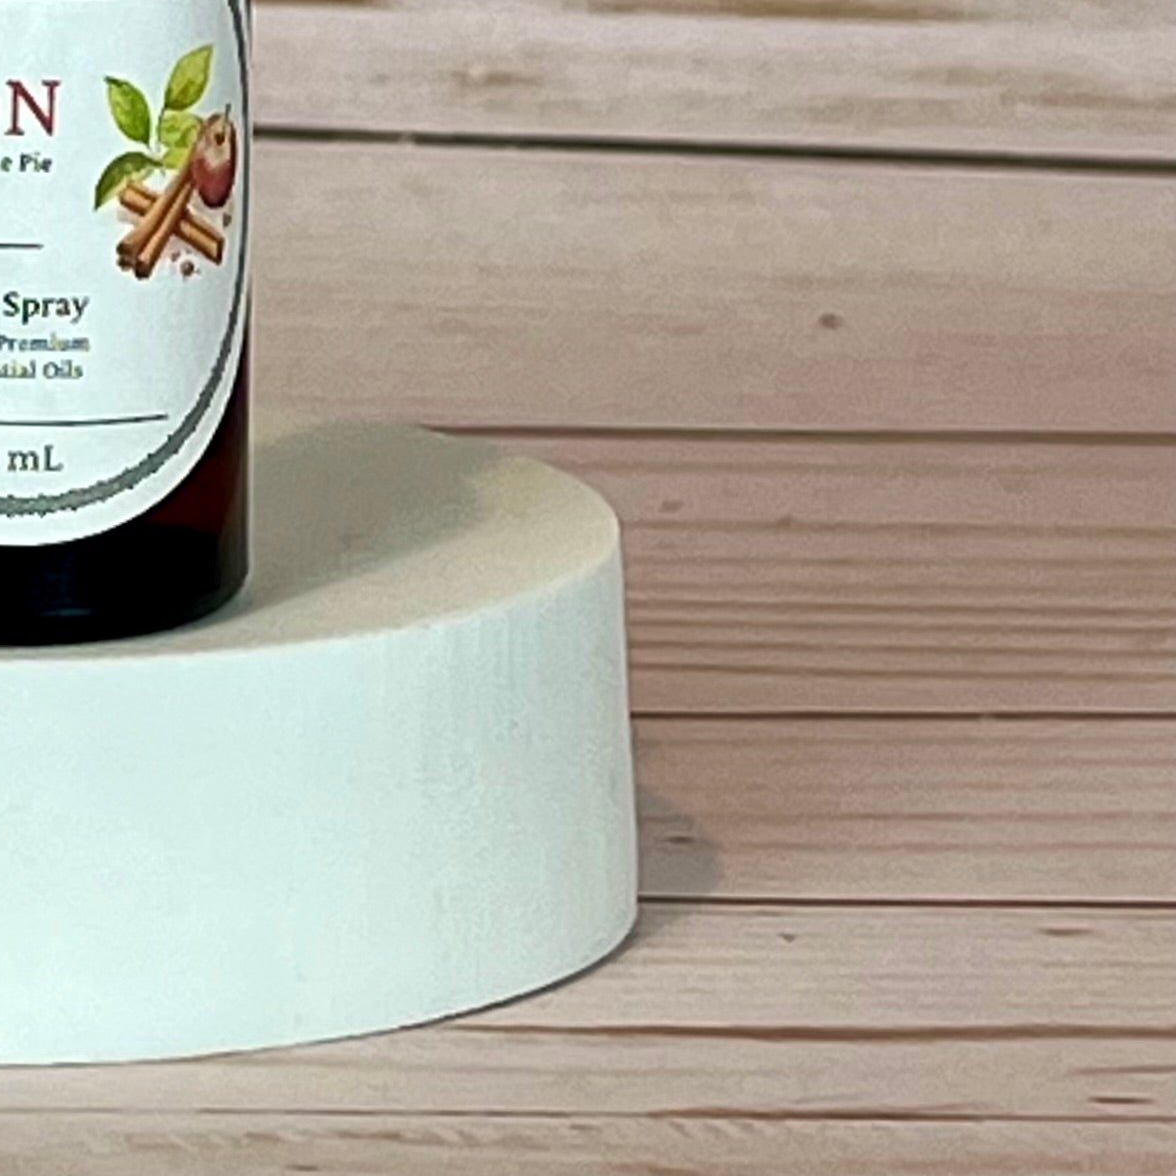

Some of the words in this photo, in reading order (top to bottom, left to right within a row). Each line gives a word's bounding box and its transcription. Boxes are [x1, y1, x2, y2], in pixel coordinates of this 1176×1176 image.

[19, 152, 53, 173] Pie
[3, 291, 89, 325] Spray
[43, 360, 84, 379] Oils
[8, 445, 63, 472] mL
